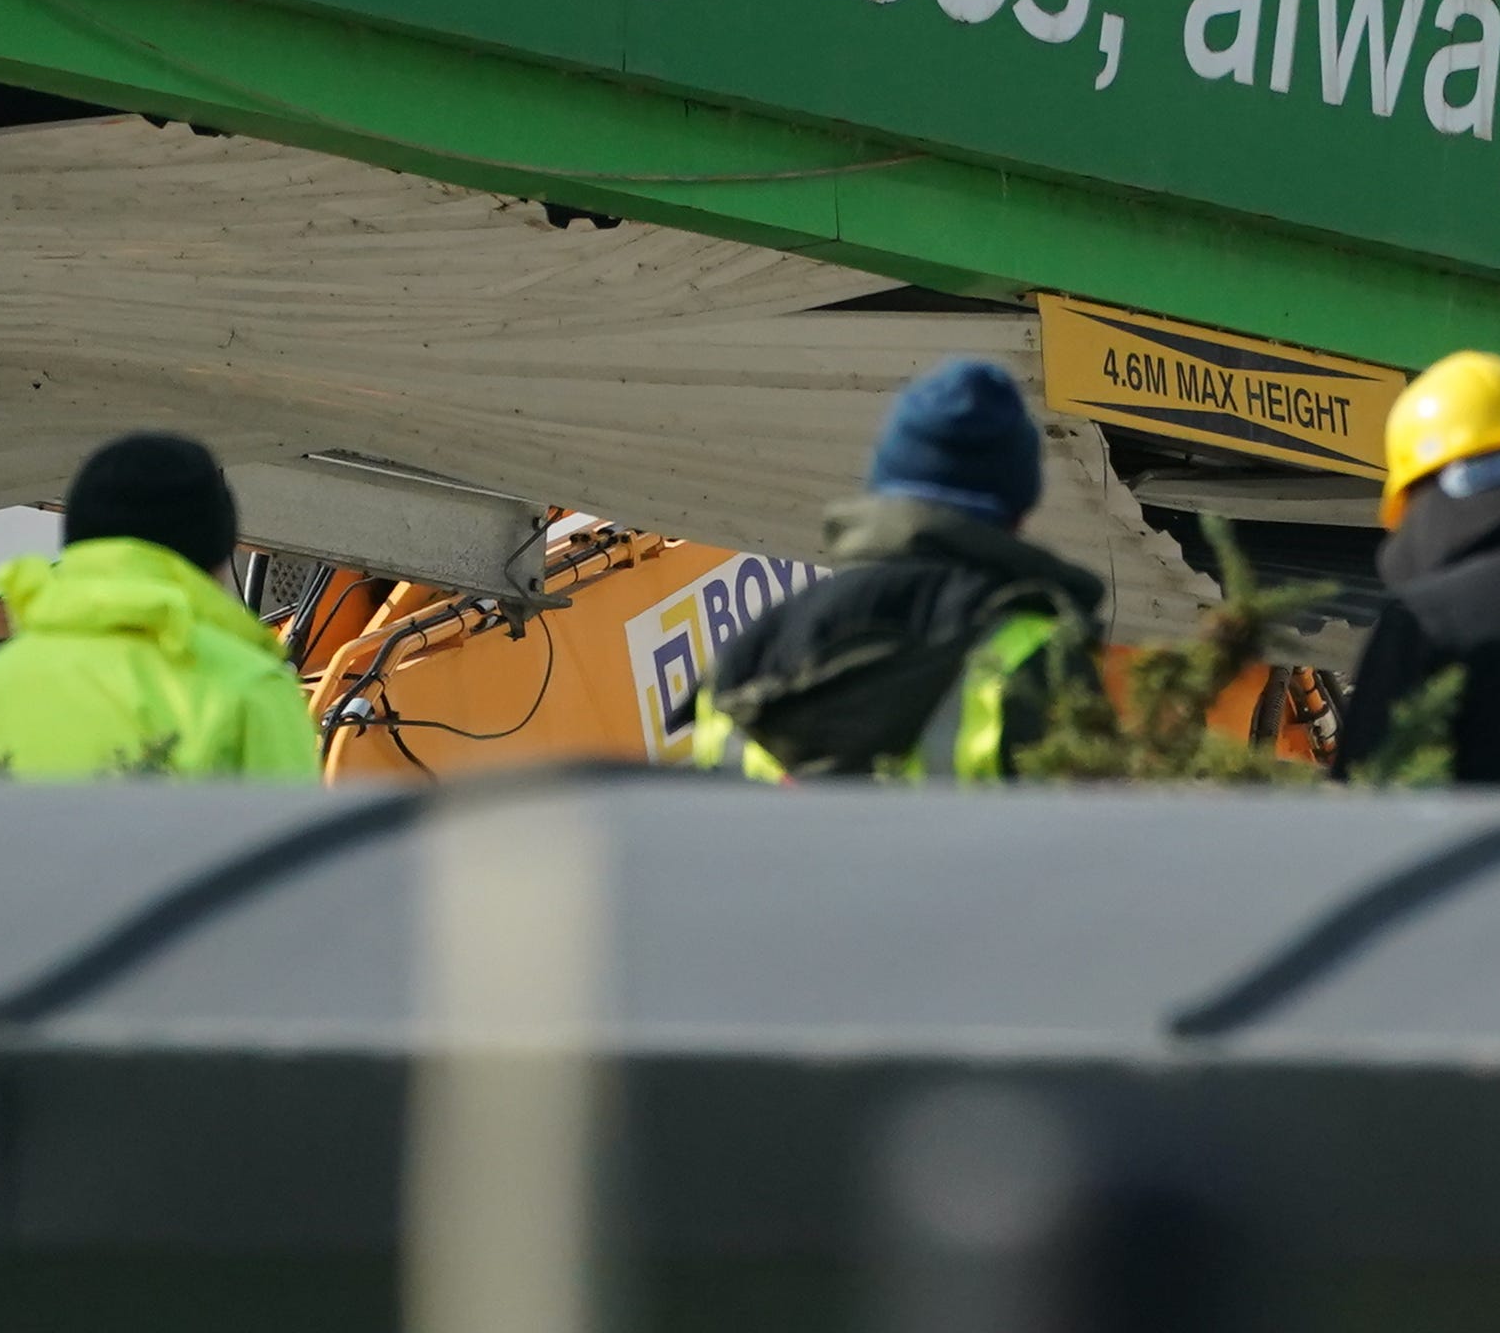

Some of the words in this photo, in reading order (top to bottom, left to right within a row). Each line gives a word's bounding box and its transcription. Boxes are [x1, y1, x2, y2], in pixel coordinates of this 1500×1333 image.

[1103, 348, 1168, 397] 4.6M
[1176, 361, 1238, 413] MAX
[1246, 376, 1351, 437] HEIGHT
